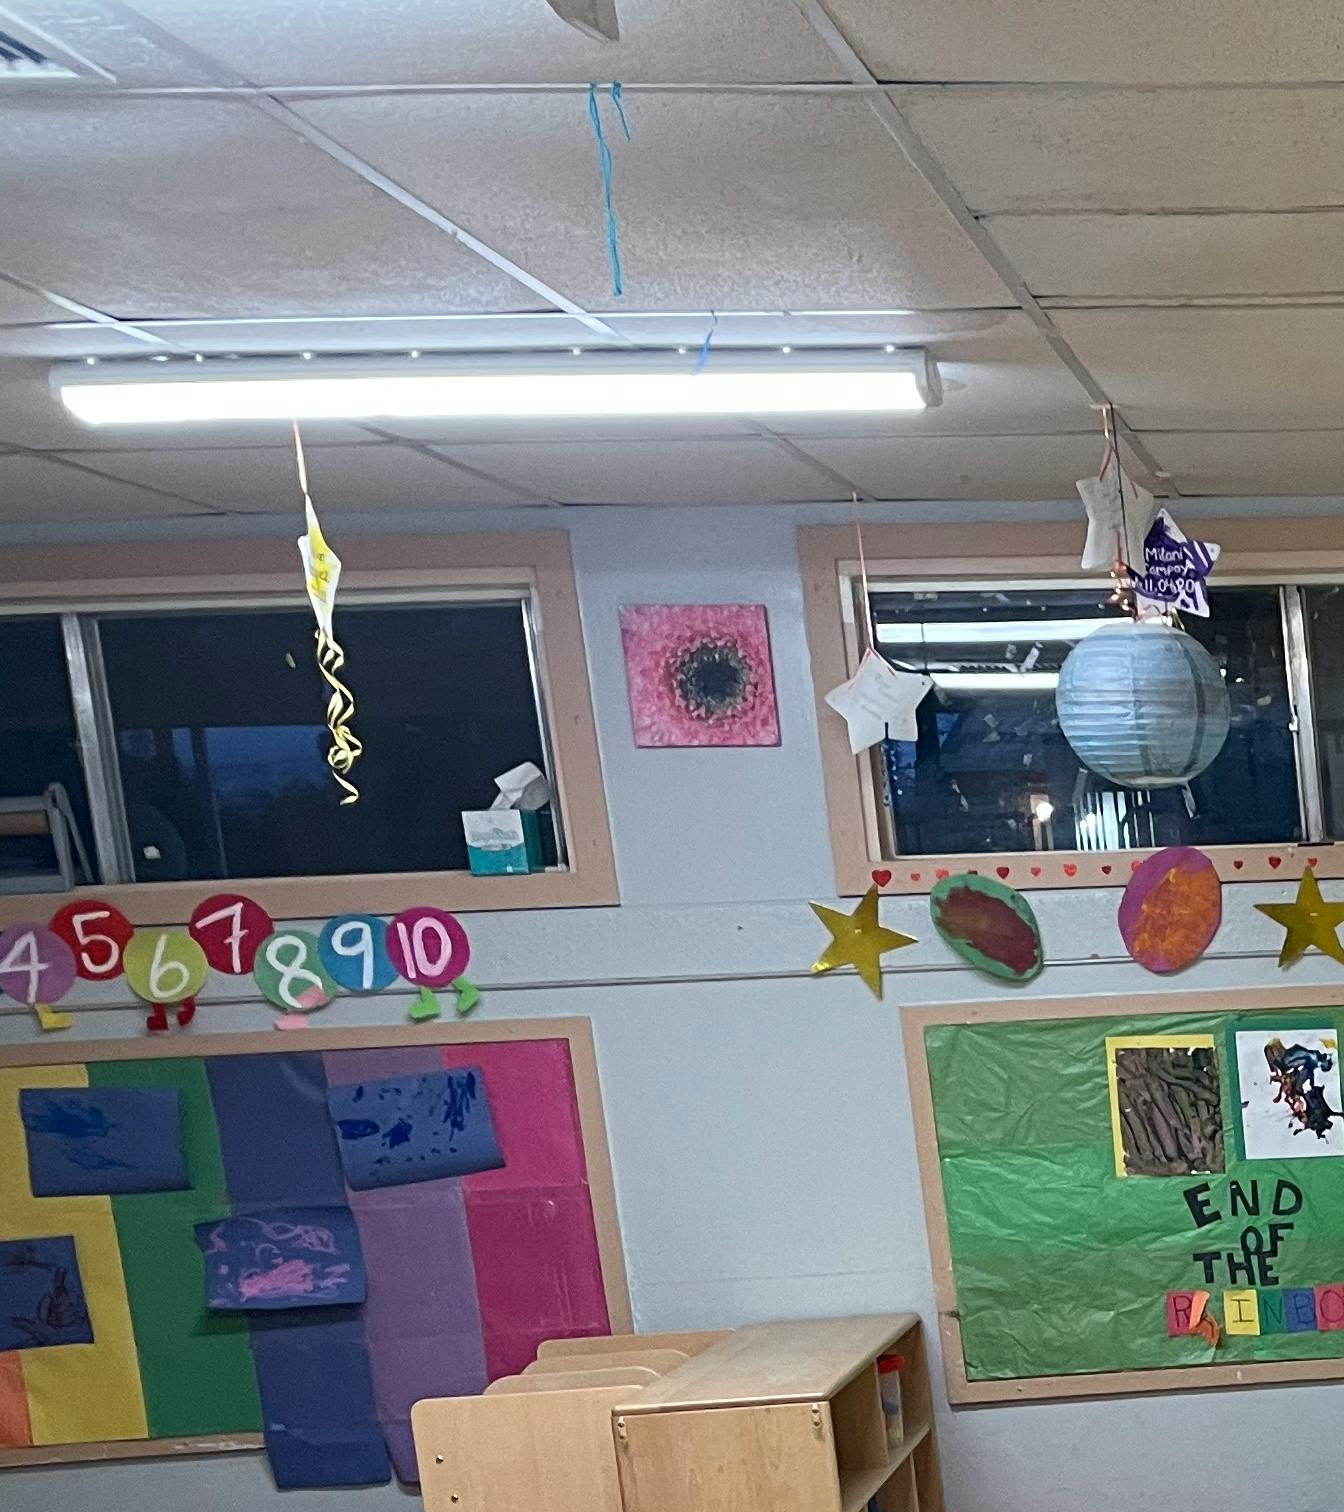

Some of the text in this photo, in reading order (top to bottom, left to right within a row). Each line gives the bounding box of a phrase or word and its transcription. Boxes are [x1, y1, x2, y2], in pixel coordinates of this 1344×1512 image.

[0, 902, 452, 1009] 4 5 6 7 8 9 10
[1183, 1179, 1303, 1228] END
[1241, 1222, 1294, 1257] OF
[1193, 1250, 1279, 1287] THE
